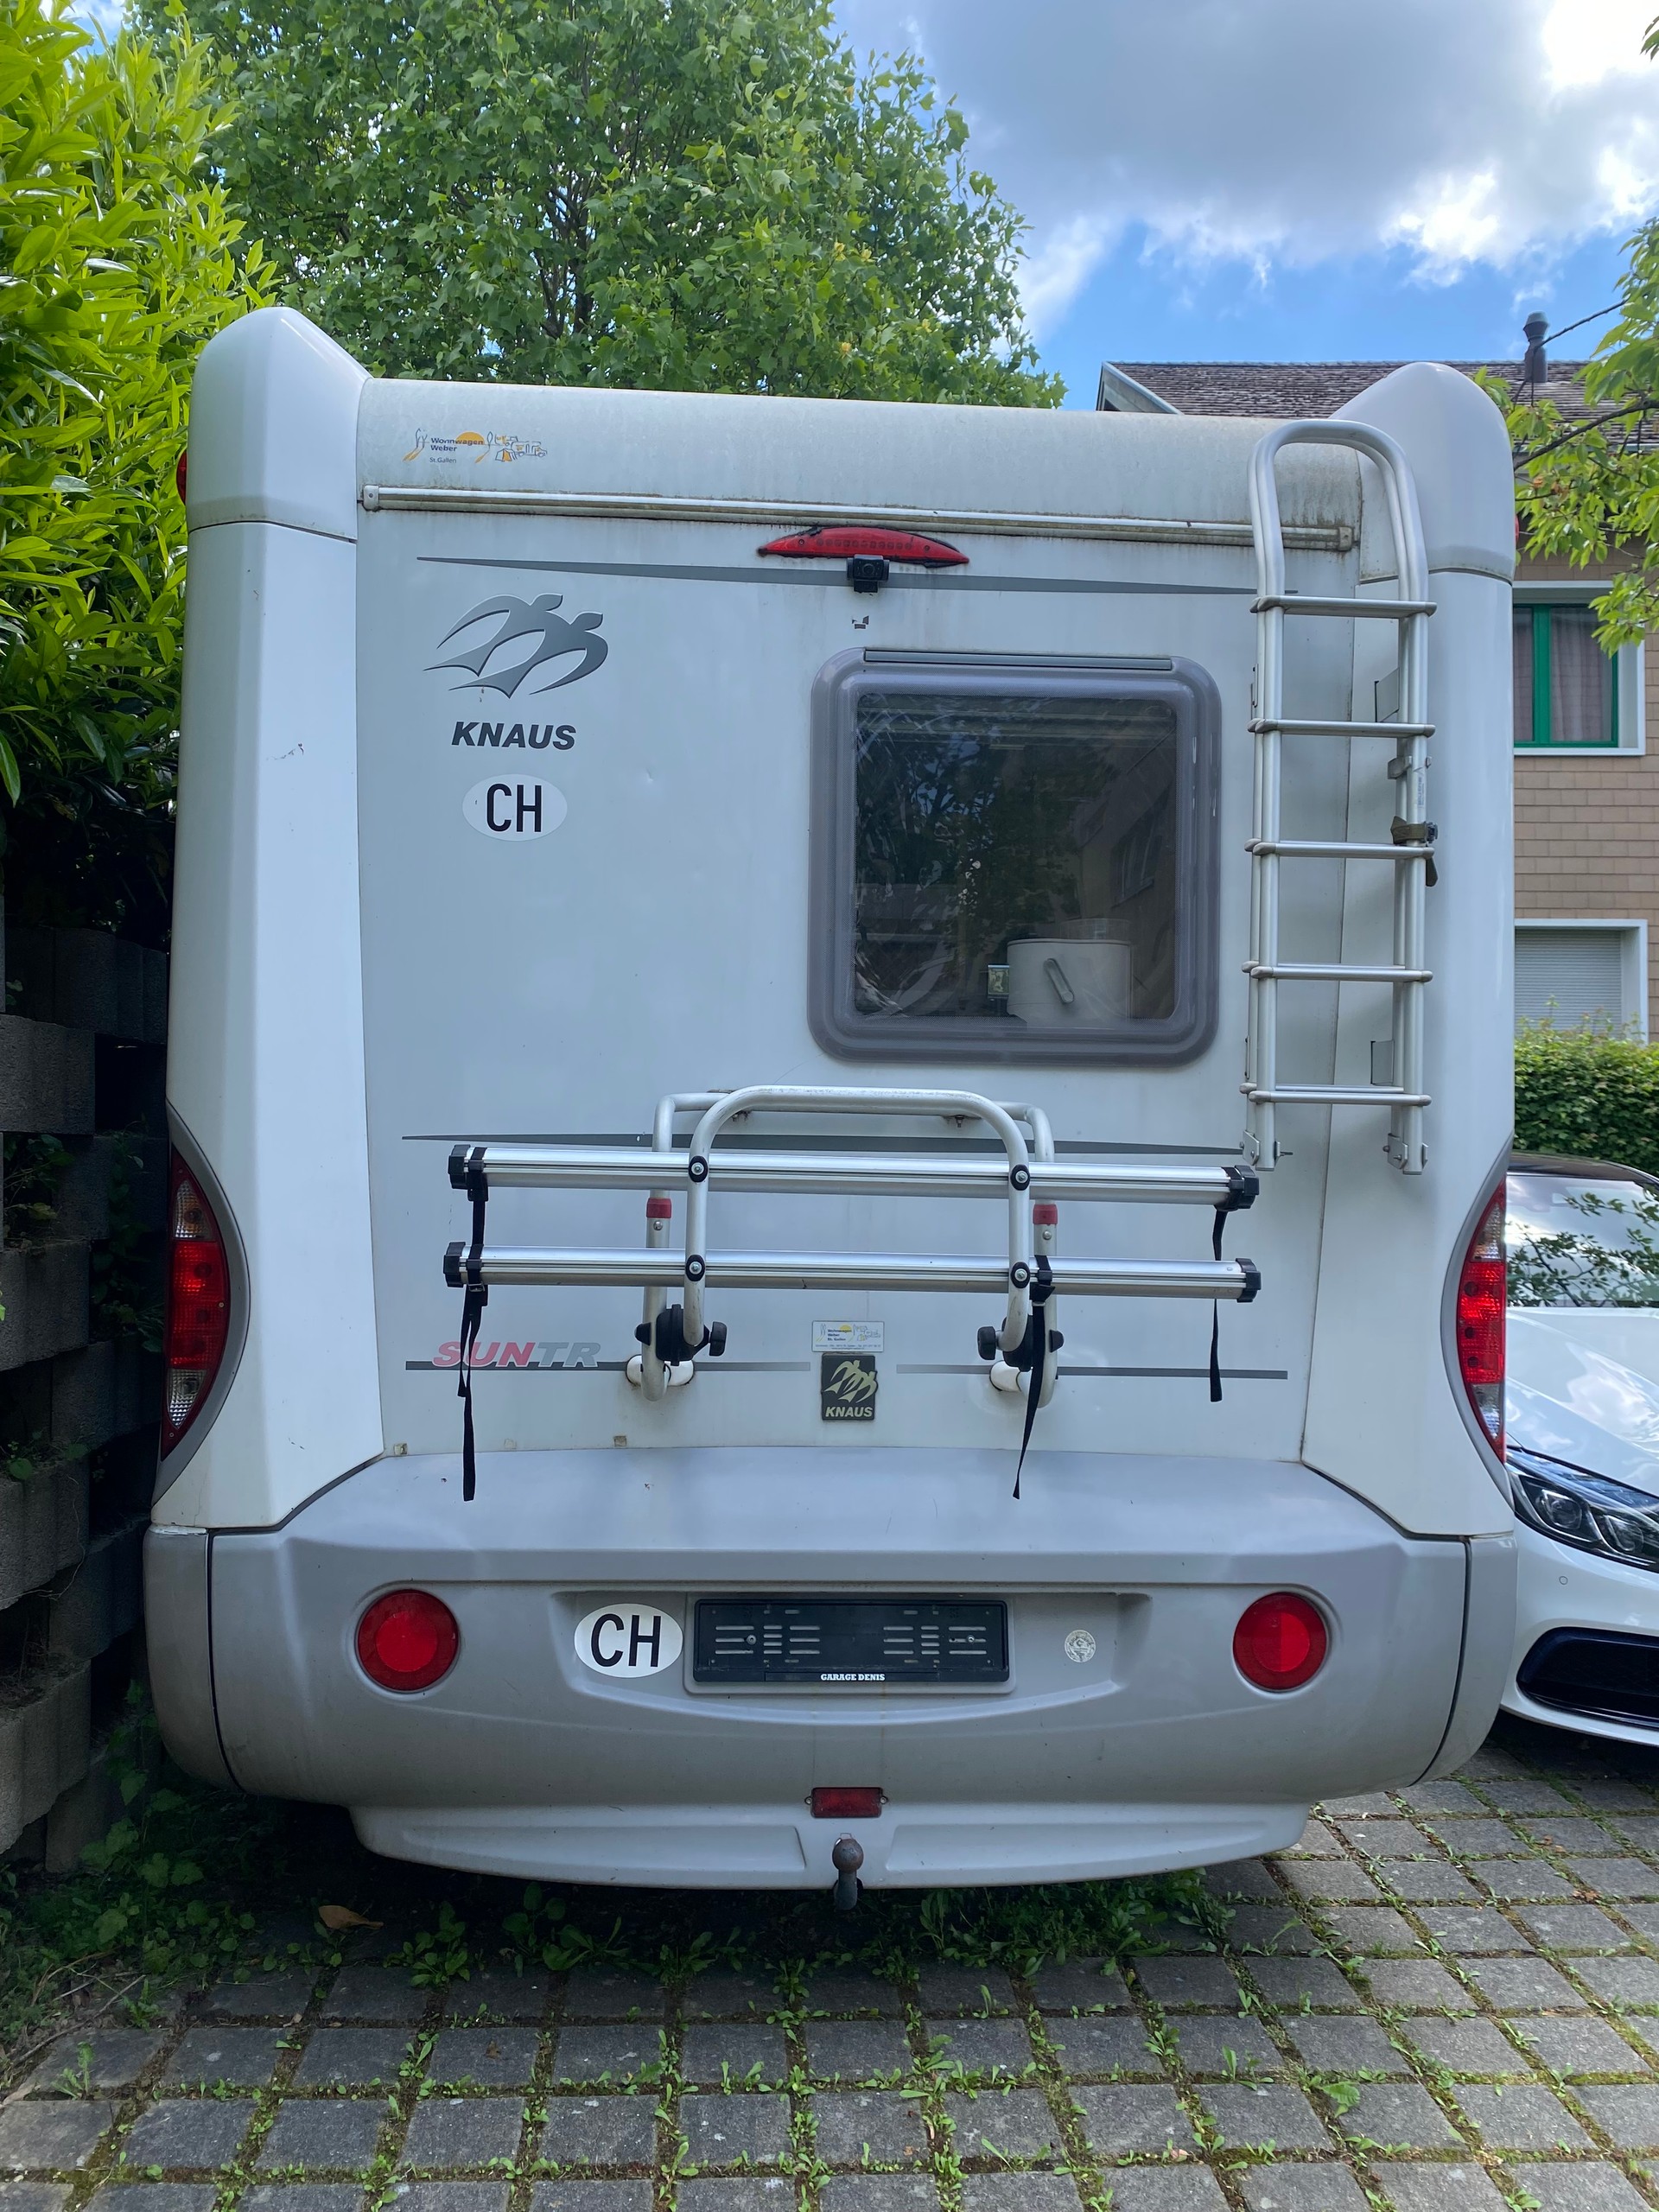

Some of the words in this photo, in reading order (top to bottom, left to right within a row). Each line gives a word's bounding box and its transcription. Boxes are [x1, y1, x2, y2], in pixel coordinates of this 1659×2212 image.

[451, 721, 576, 750] KNAUS
[486, 784, 542, 832] CH
[825, 1406, 874, 1417] KNAUS
[591, 1613, 662, 1668] CH
[857, 1673, 886, 1681] DENIS
